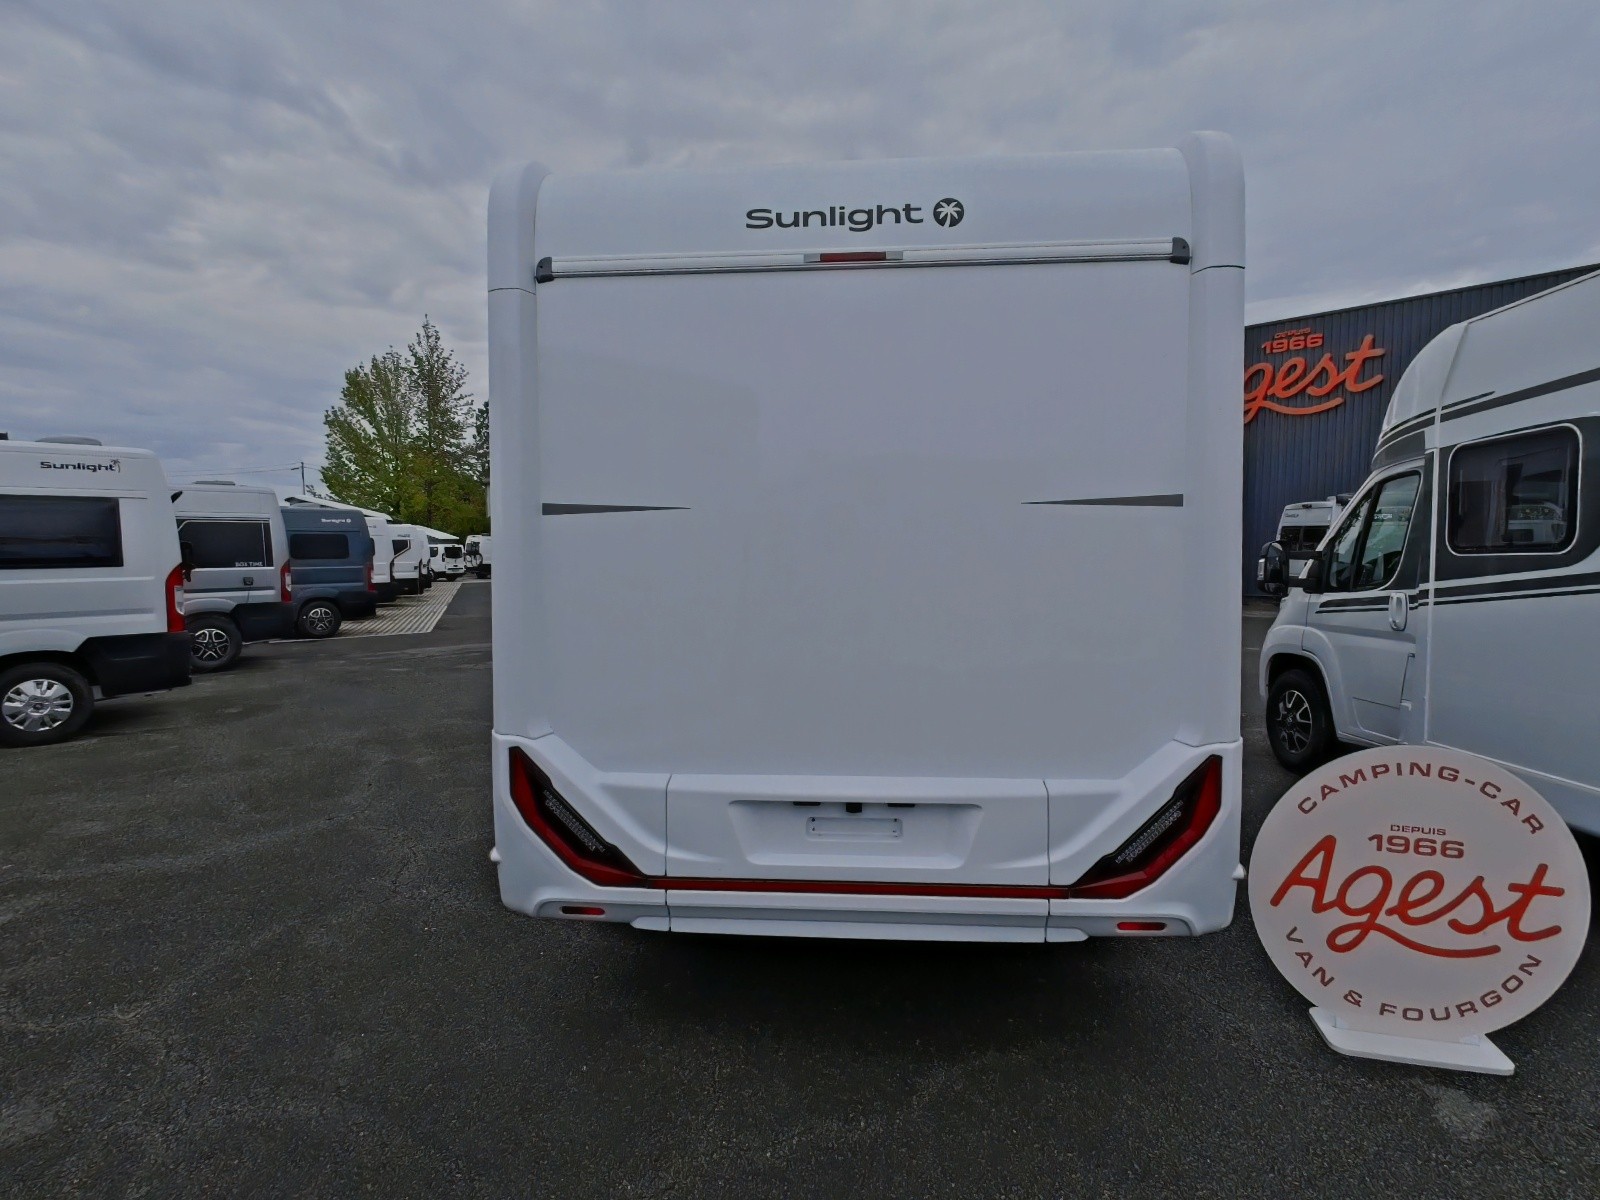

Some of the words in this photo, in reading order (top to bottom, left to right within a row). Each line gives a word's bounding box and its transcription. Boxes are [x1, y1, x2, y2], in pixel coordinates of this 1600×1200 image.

[746, 203, 924, 232] Sunlight
[1261, 333, 1323, 354] 1966
[1244, 334, 1385, 424] gest
[40, 461, 116, 473] Sunlight
[1297, 761, 1545, 835] CAMPING-CAR
[1389, 824, 1447, 836] DEPUIS
[1368, 833, 1465, 859] 1966
[1270, 834, 1565, 959] Agest
[1285, 926, 1335, 987] VAN
[1343, 989, 1364, 1008] &
[1379, 954, 1543, 1022] FOURGON
